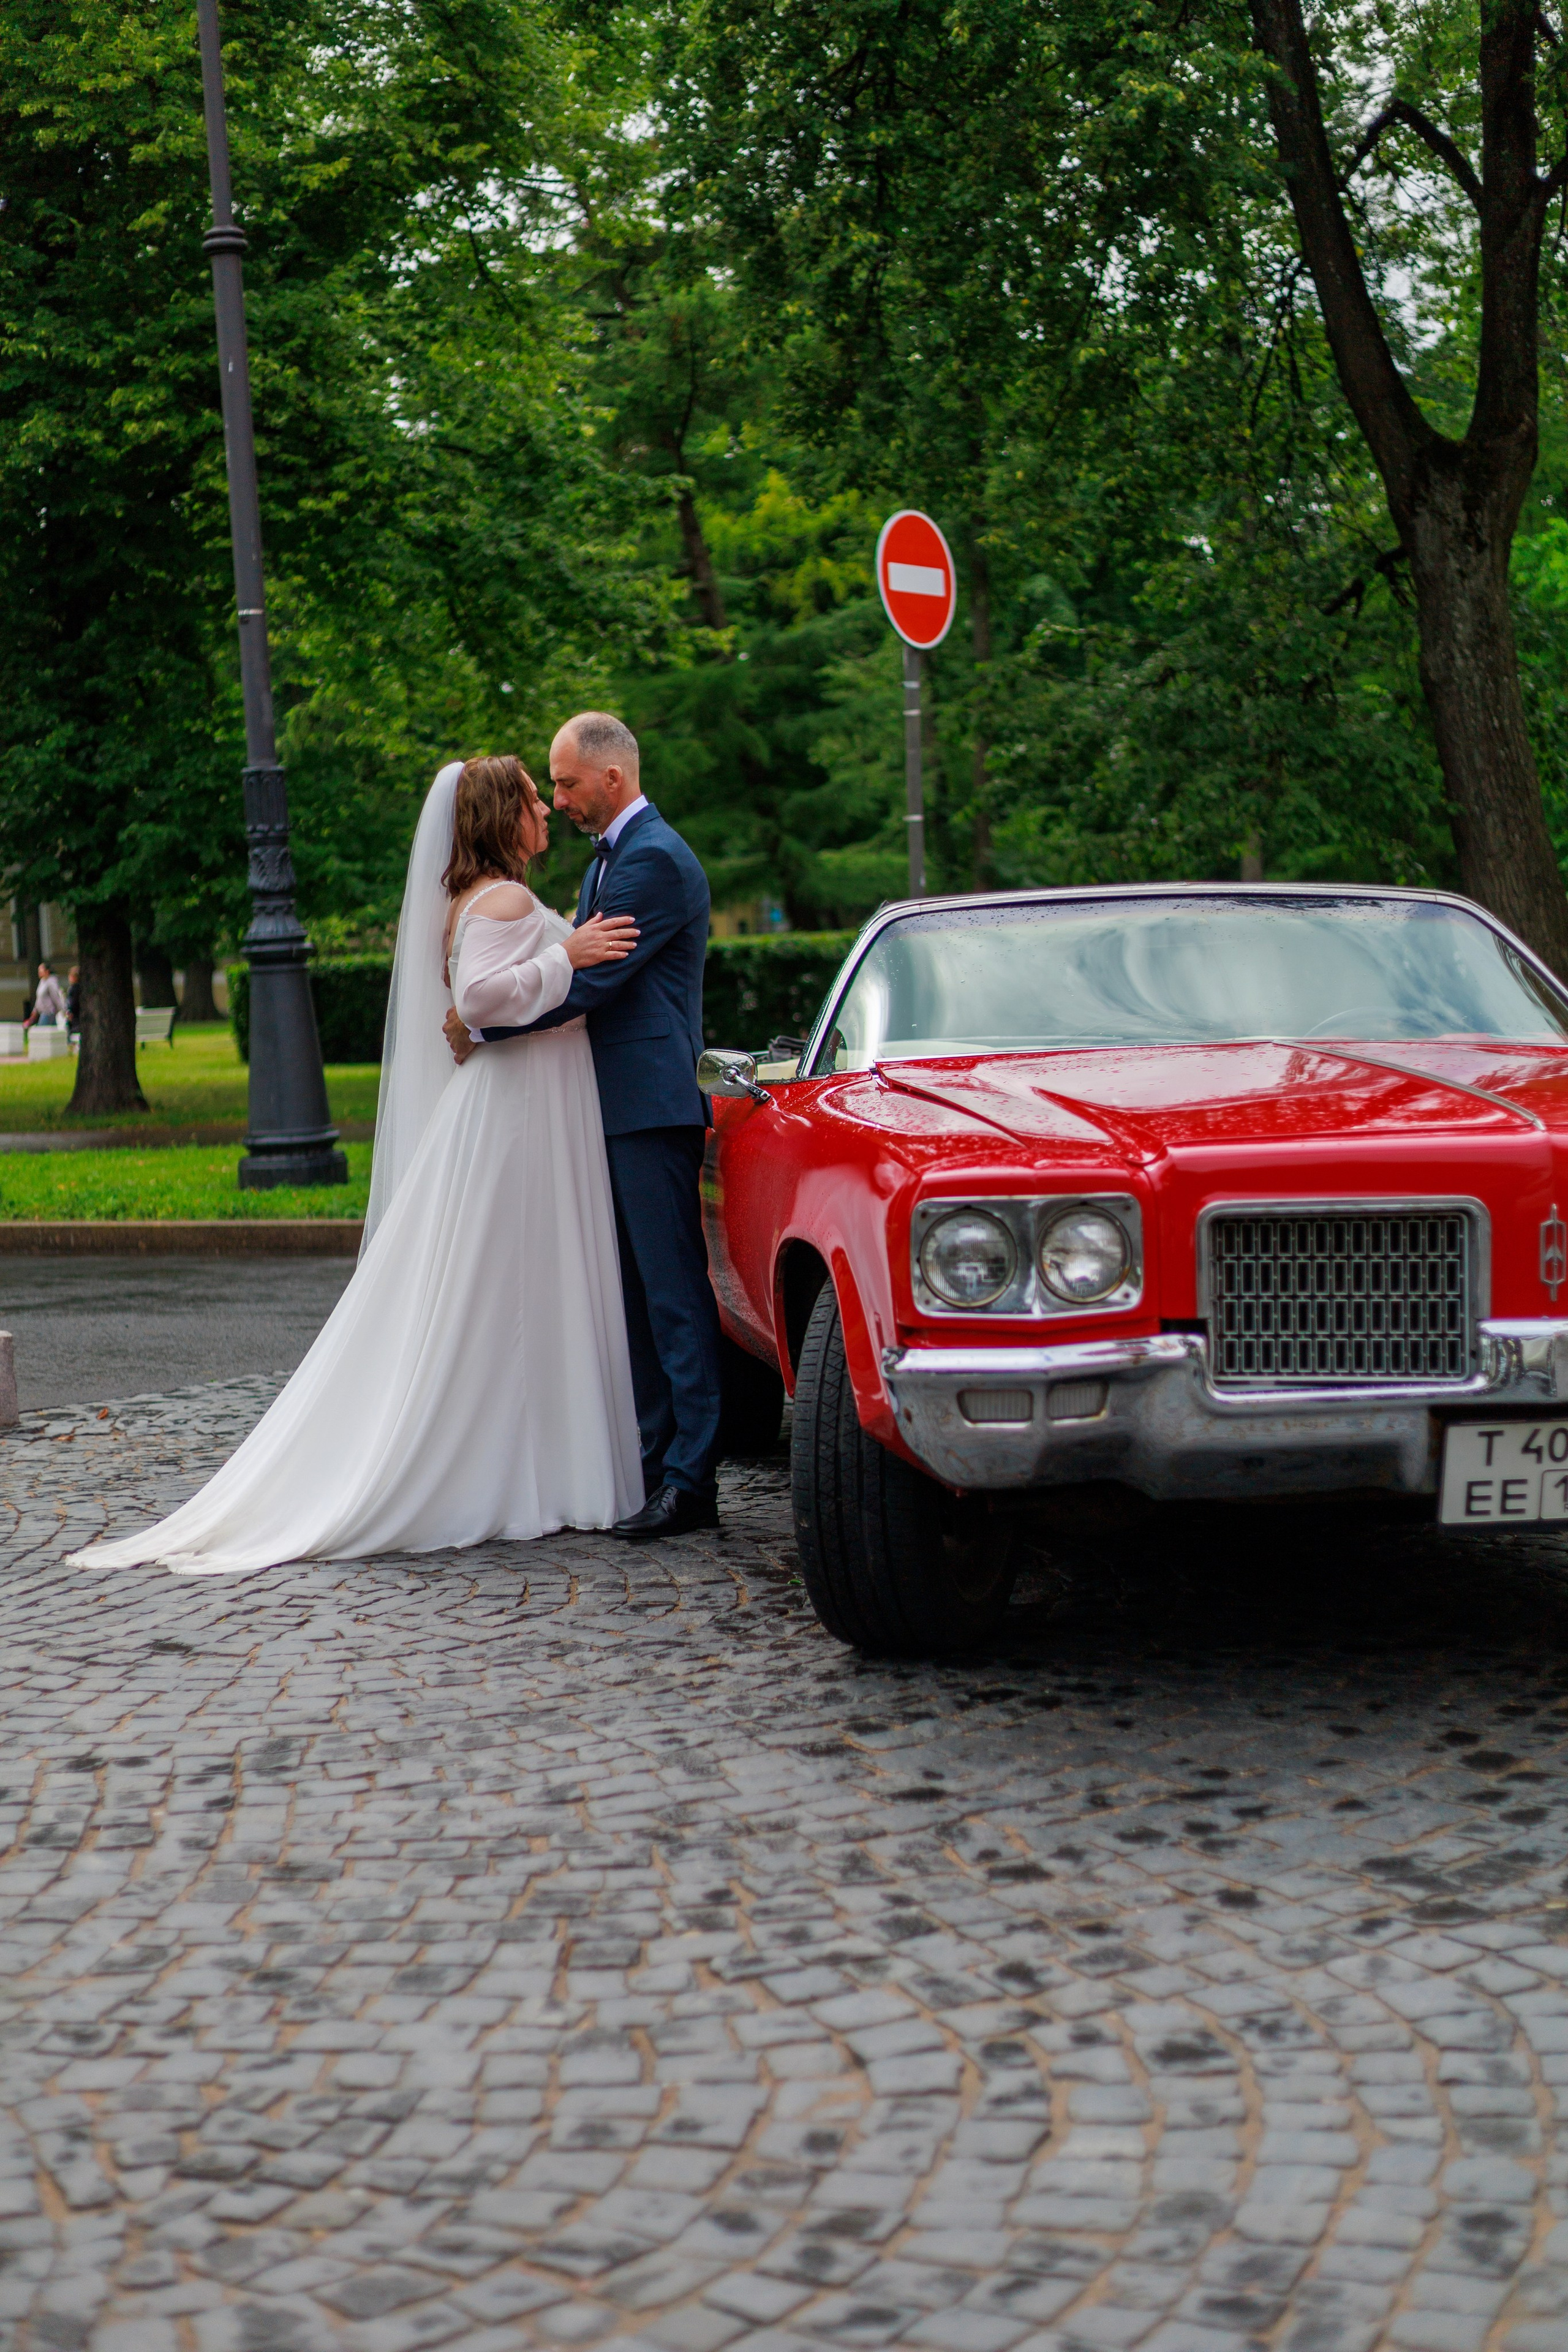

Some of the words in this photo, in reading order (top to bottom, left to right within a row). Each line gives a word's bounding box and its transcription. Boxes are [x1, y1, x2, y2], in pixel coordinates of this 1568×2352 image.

[1477, 1430, 1505, 1466] T
[1521, 1427, 1568, 1464] 40
[1465, 1479, 1528, 1517] EE
